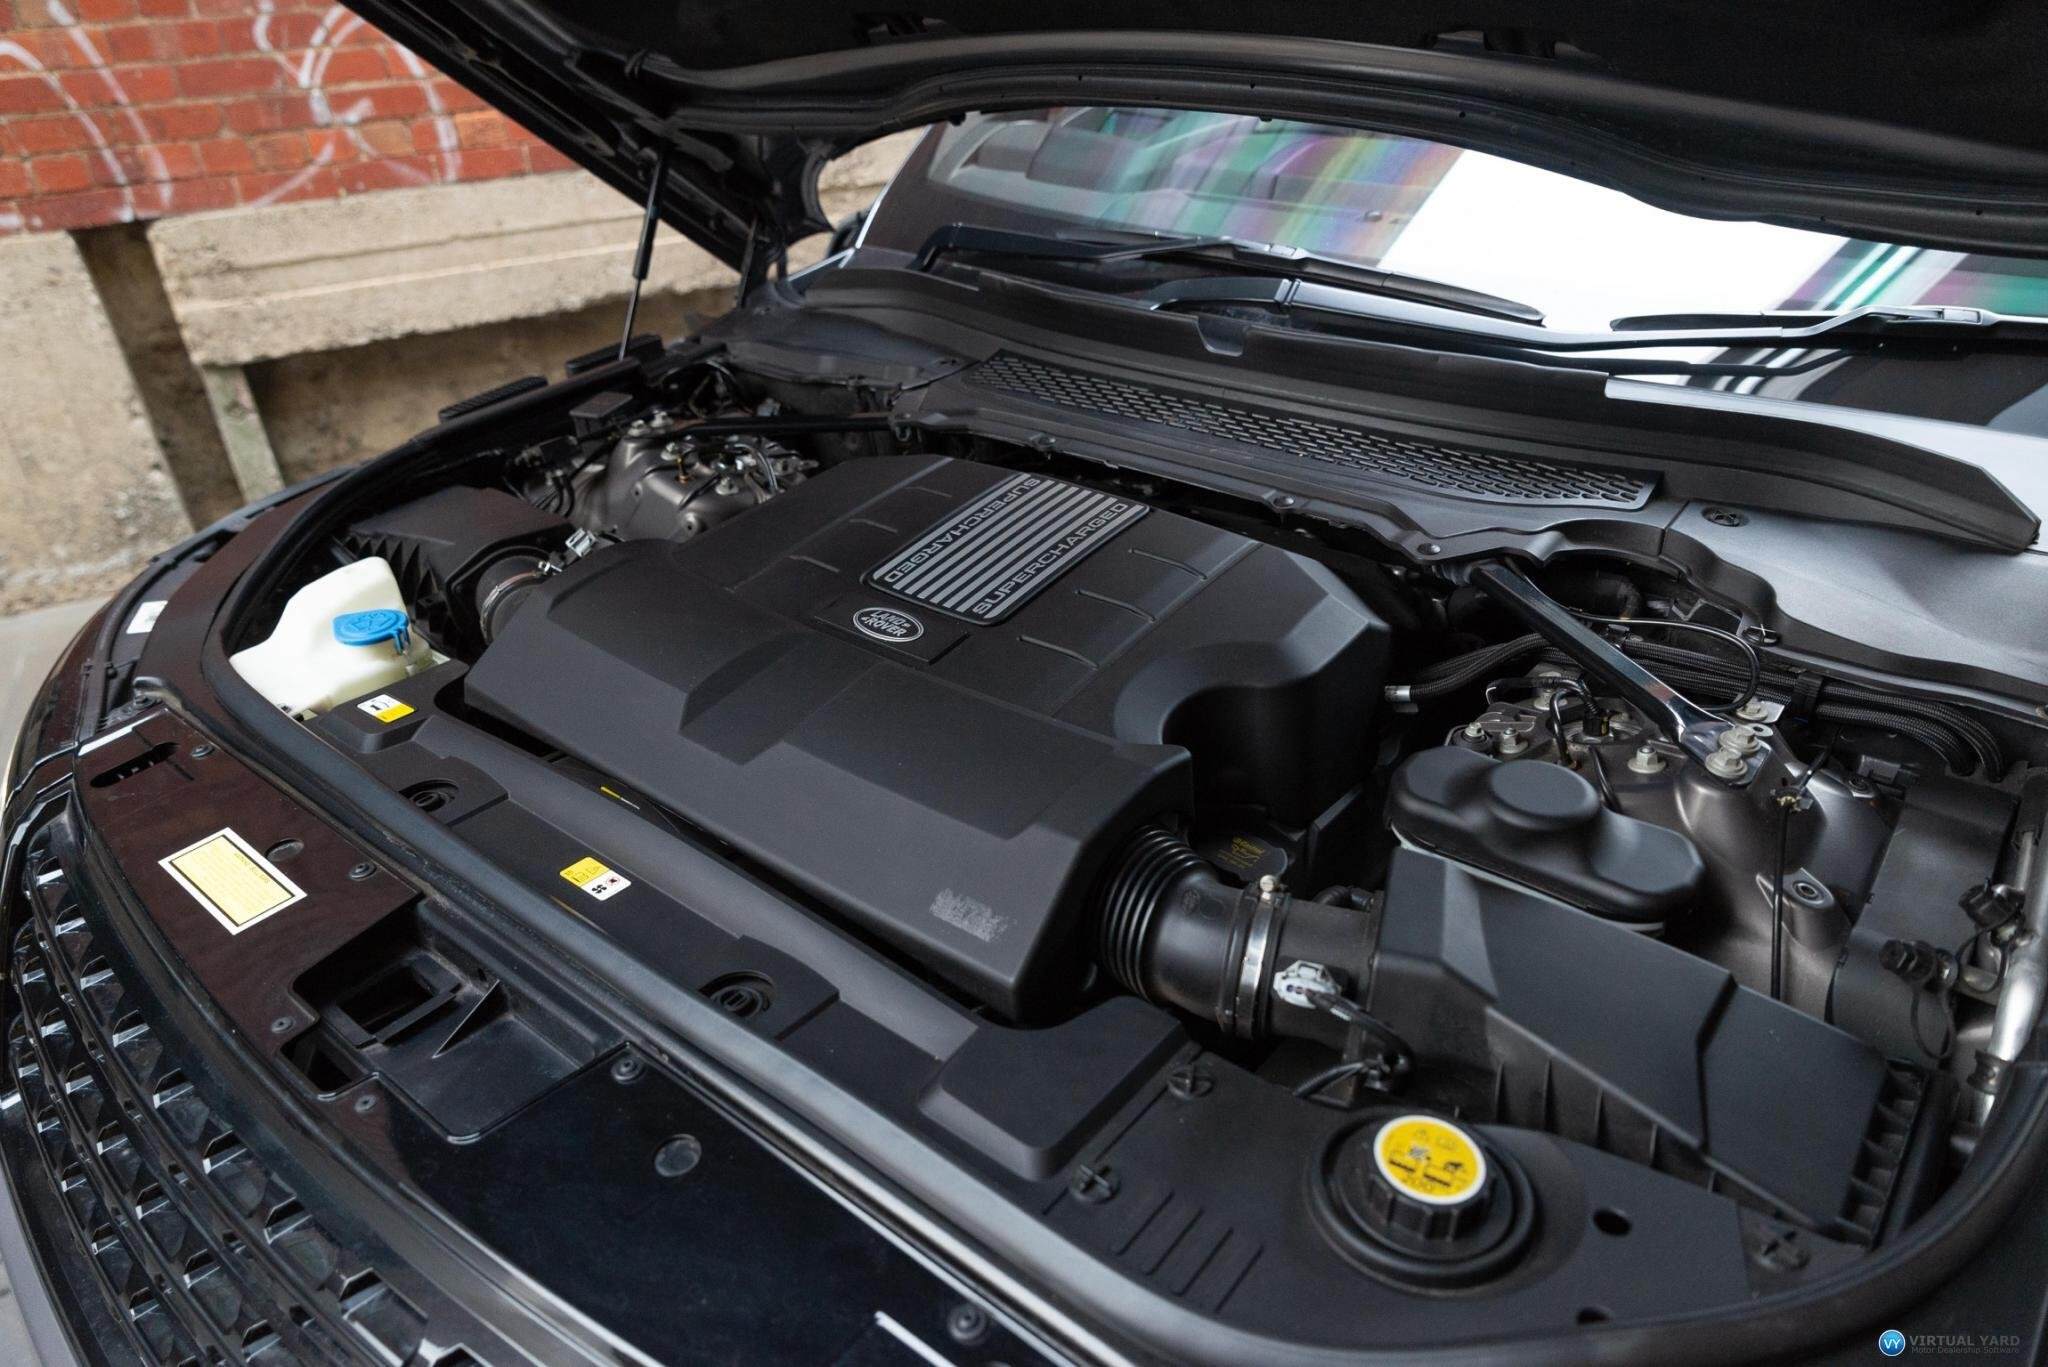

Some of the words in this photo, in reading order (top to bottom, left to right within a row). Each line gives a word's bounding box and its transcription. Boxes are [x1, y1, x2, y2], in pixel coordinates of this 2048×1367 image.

[885, 478, 1041, 583] SUPERCHARGED
[973, 502, 1129, 615] SUPERCHARGED
[864, 616, 907, 637] ROVER
[870, 610, 906, 627] LAND
